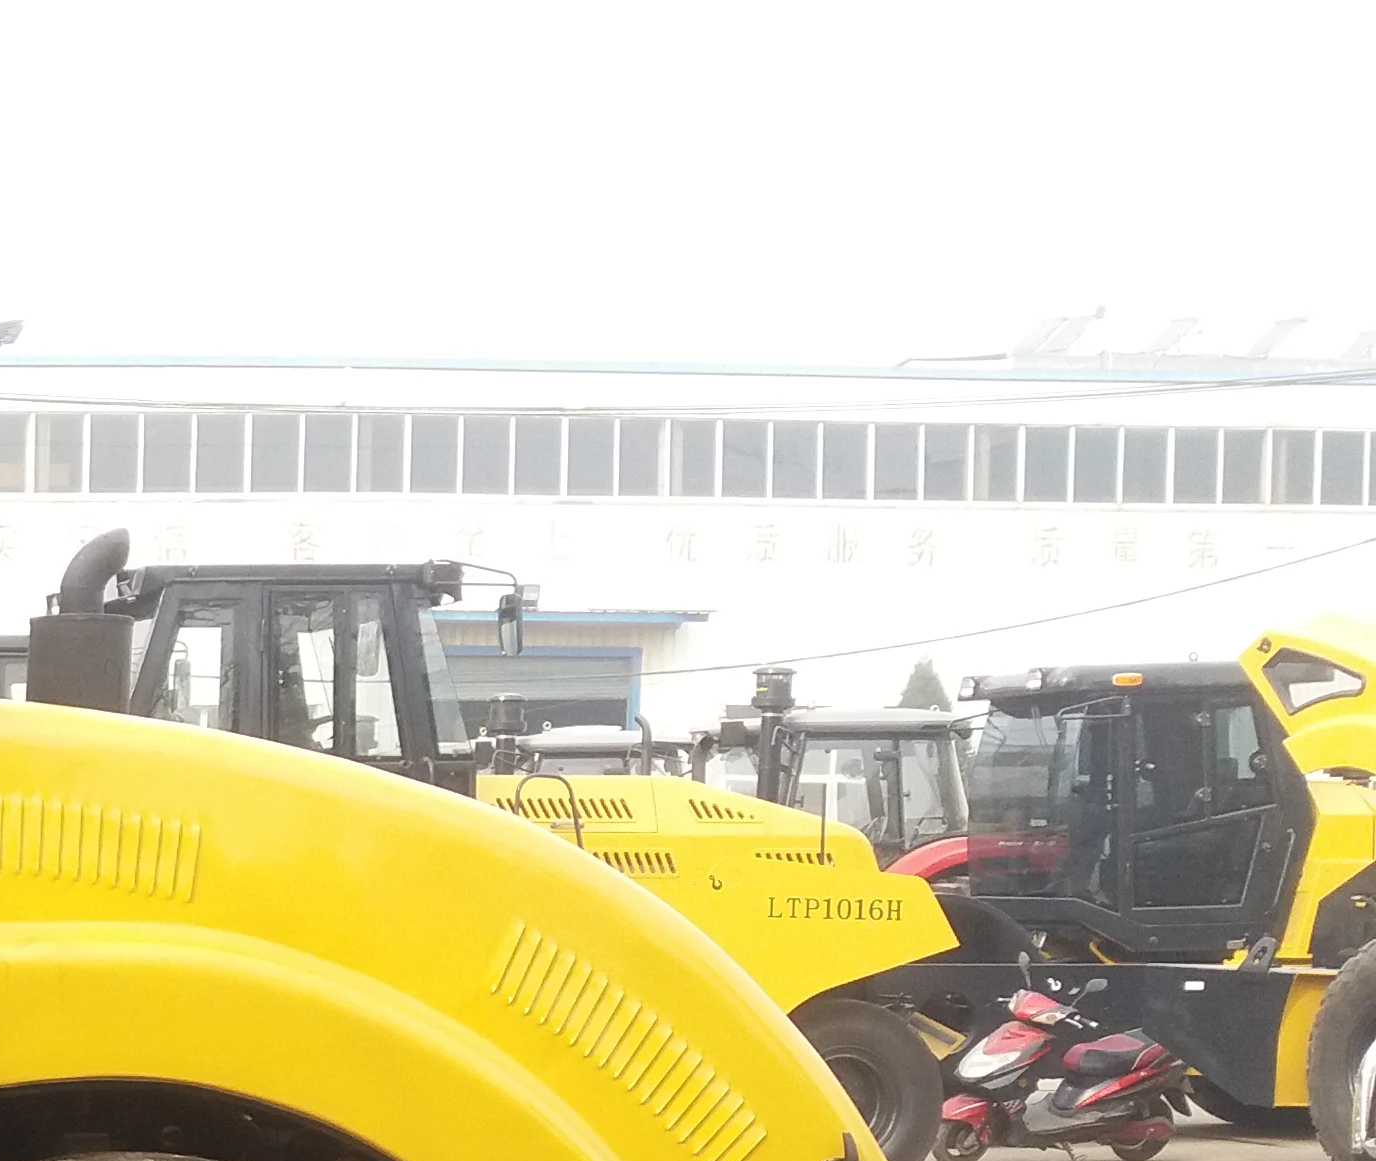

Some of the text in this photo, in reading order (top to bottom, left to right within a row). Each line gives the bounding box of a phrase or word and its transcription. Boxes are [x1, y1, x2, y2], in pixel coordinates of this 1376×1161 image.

[665, 523, 937, 568] 优质服务
[1030, 525, 1296, 569] 质量第一
[767, 896, 903, 921] LTP1016H
